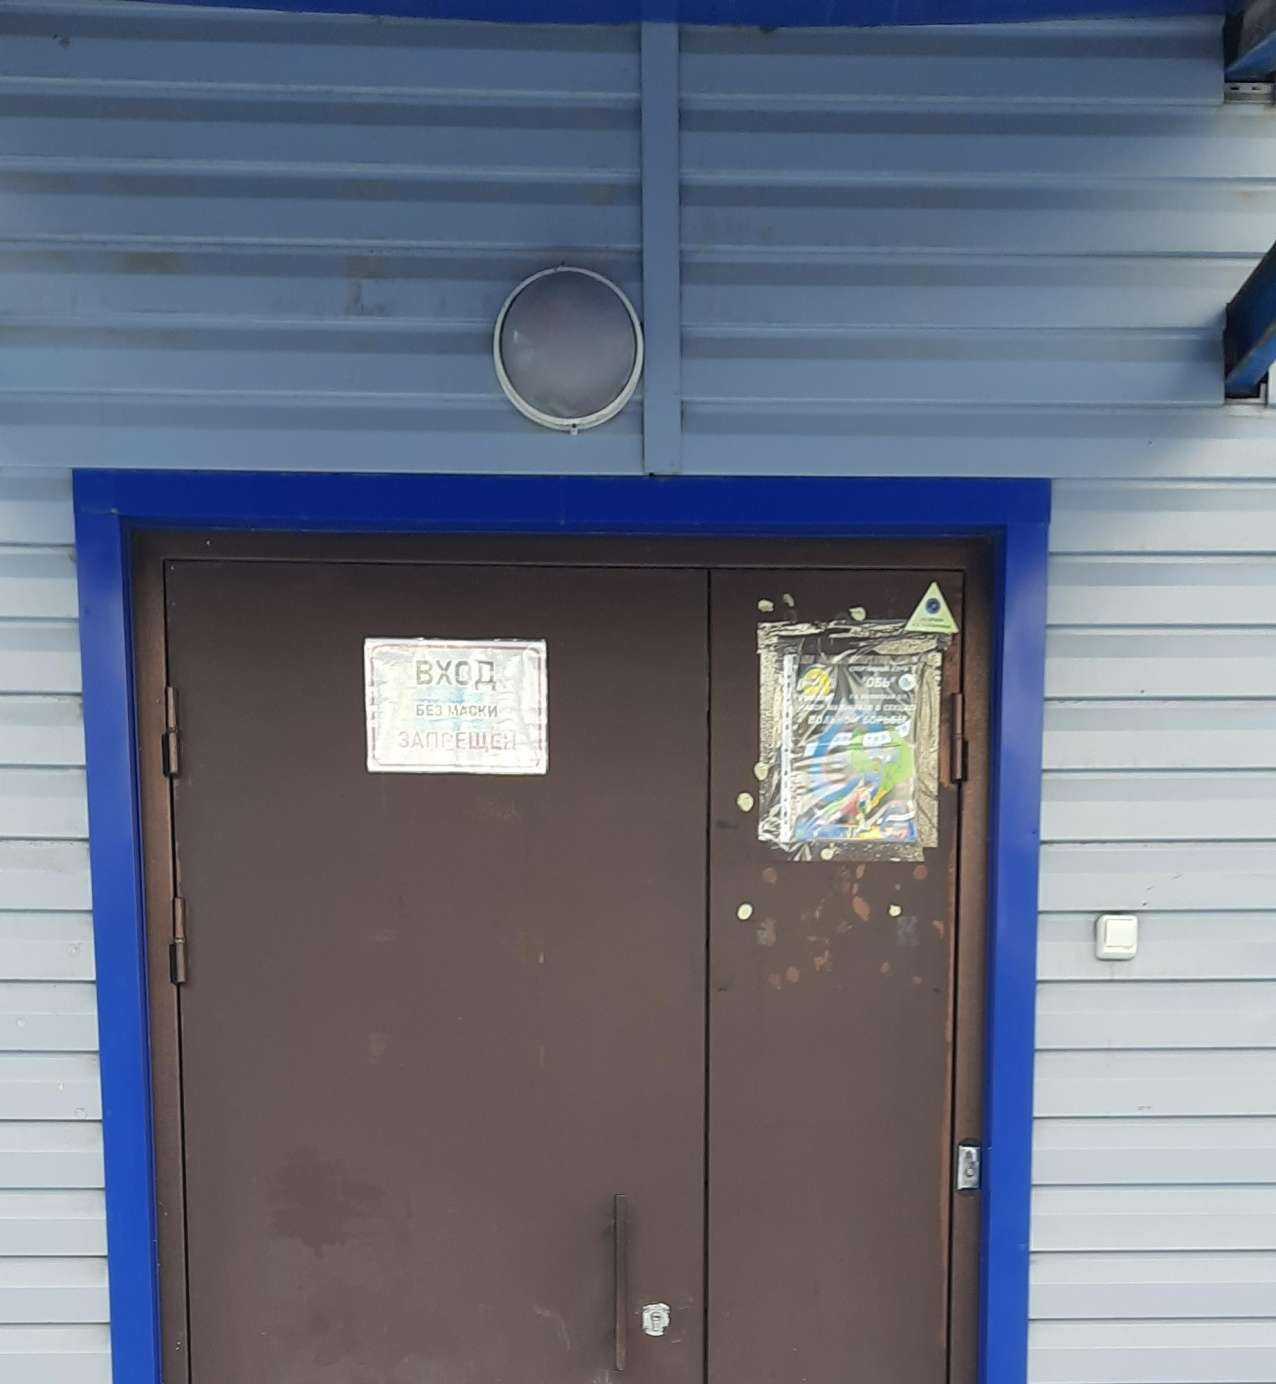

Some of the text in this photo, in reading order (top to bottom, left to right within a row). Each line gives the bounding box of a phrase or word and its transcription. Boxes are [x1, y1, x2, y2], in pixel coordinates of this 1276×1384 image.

[415, 660, 497, 691] ВХОД
[416, 704, 498, 717] БЕЗ МАСКИ
